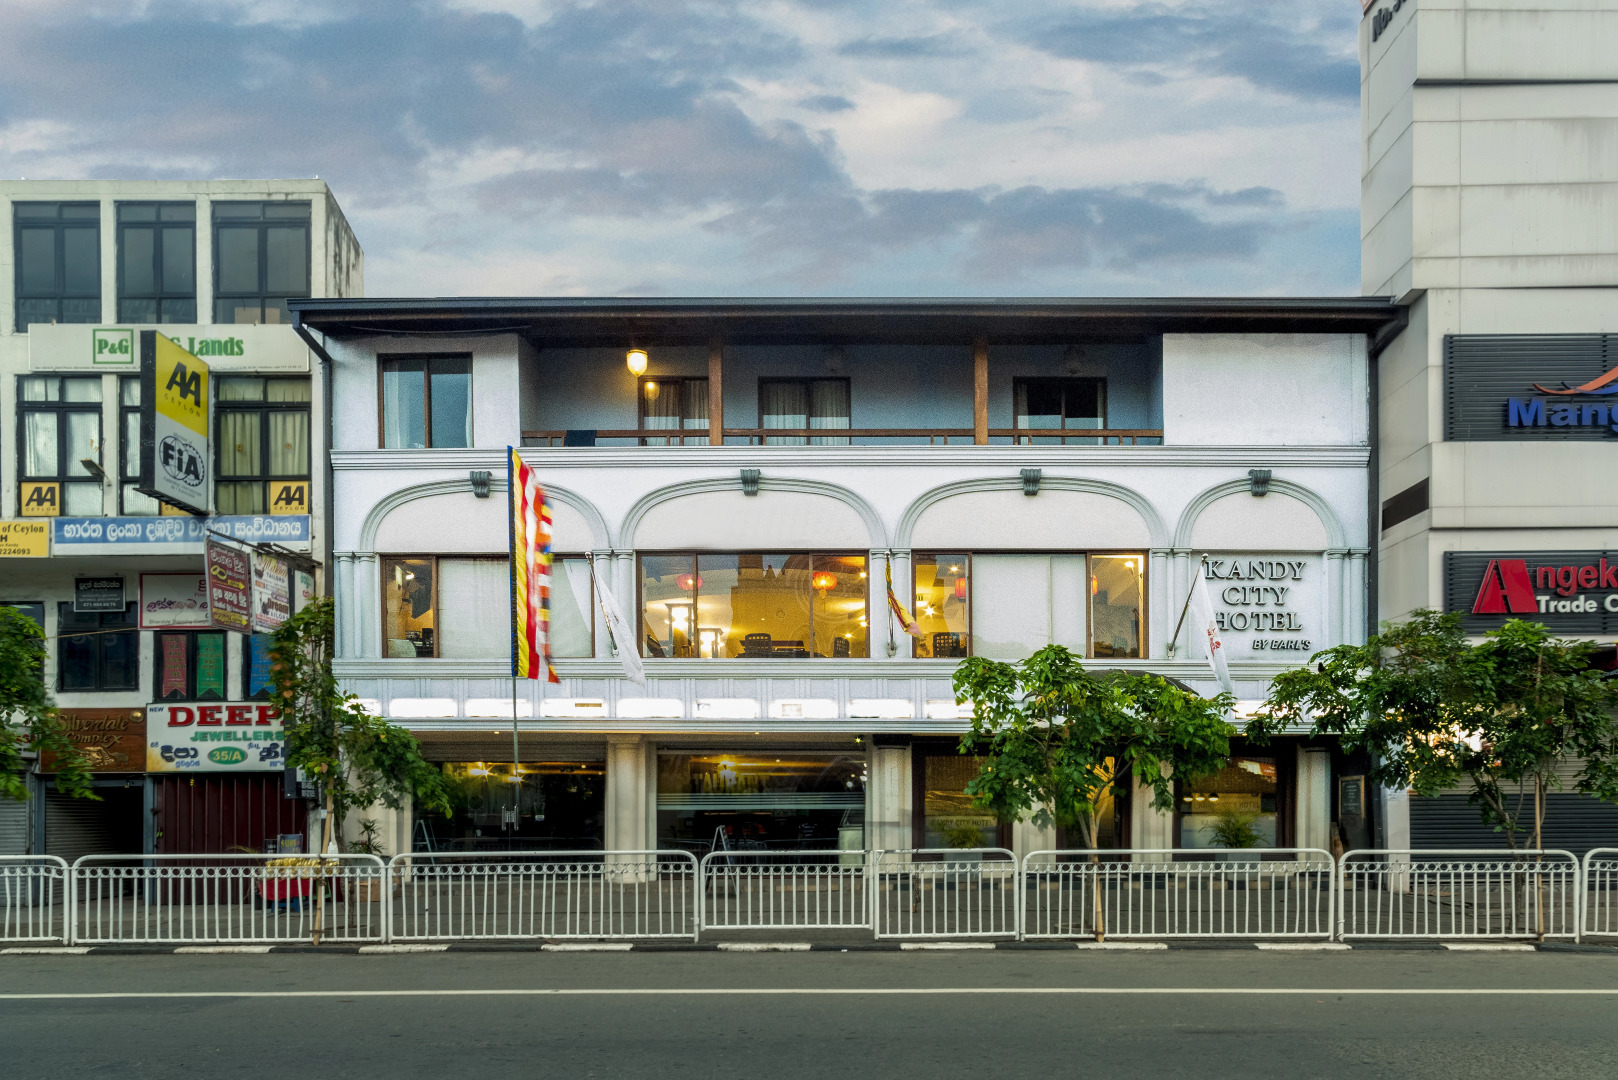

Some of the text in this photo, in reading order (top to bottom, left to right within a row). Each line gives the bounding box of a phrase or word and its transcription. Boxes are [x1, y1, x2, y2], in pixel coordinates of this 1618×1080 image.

[97, 339, 130, 355] P&G
[187, 337, 245, 357] Lands
[165, 361, 201, 408] AA
[164, 393, 200, 417] CEYLON
[25, 486, 56, 507] AA
[273, 485, 304, 506] AA
[2, 523, 44, 535] of Ceylon
[1205, 560, 1306, 580] KANDY
[267, 597, 289, 614] Dream
[1222, 586, 1289, 606] CITY
[1536, 594, 1598, 613] Trade
[1215, 611, 1303, 631] HOTEL
[1252, 639, 1312, 650] BY EARL'S
[58, 714, 129, 732] Silverdale
[167, 705, 284, 727] DEEP
[64, 732, 123, 749] Complex
[190, 730, 284, 742] JEWELLERS
[212, 751, 242, 761] 35/A
